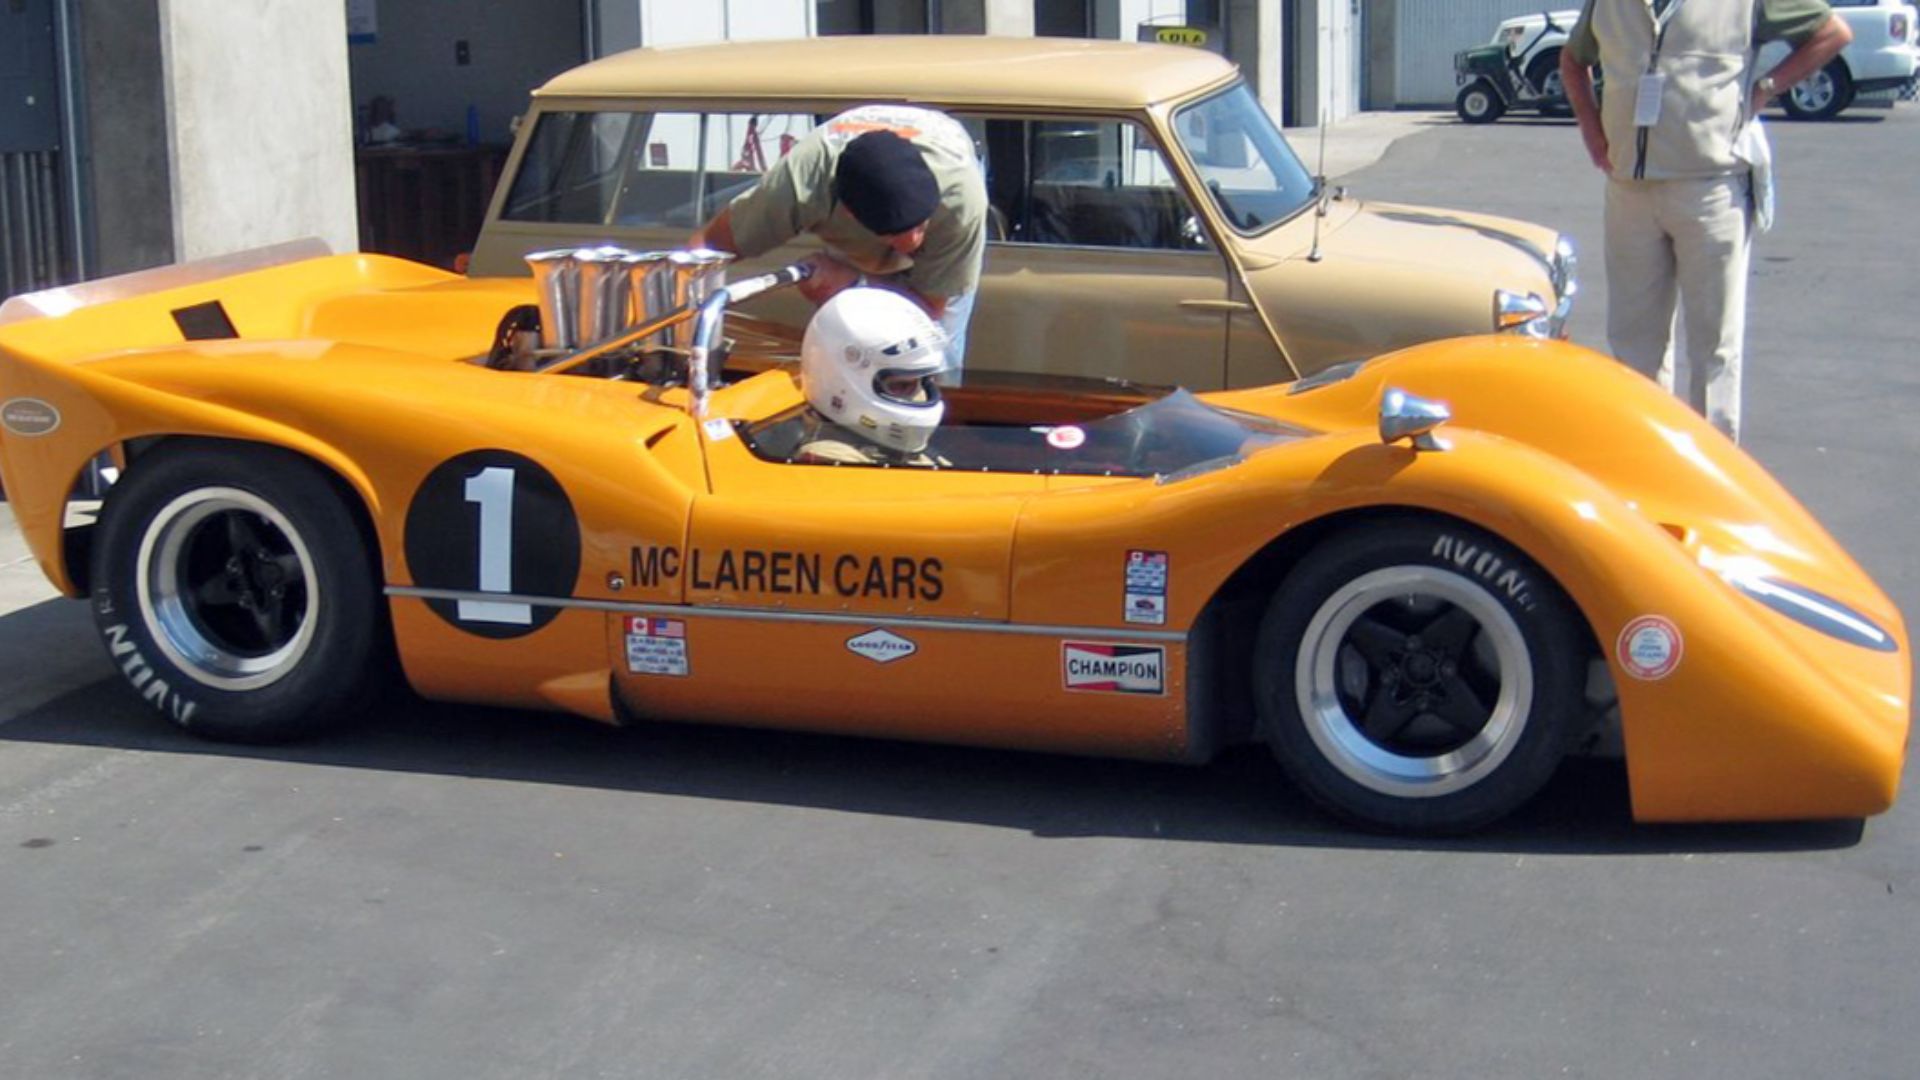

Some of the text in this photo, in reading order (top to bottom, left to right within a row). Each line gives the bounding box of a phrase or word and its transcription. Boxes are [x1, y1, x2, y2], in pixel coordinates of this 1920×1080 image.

[1158, 33, 1204, 44] LOLA
[457, 467, 532, 624] 1
[1432, 534, 1526, 598] AVON
[834, 554, 944, 600] CARS
[104, 624, 195, 725] AVON
[1068, 659, 1158, 680] CHAMPION
